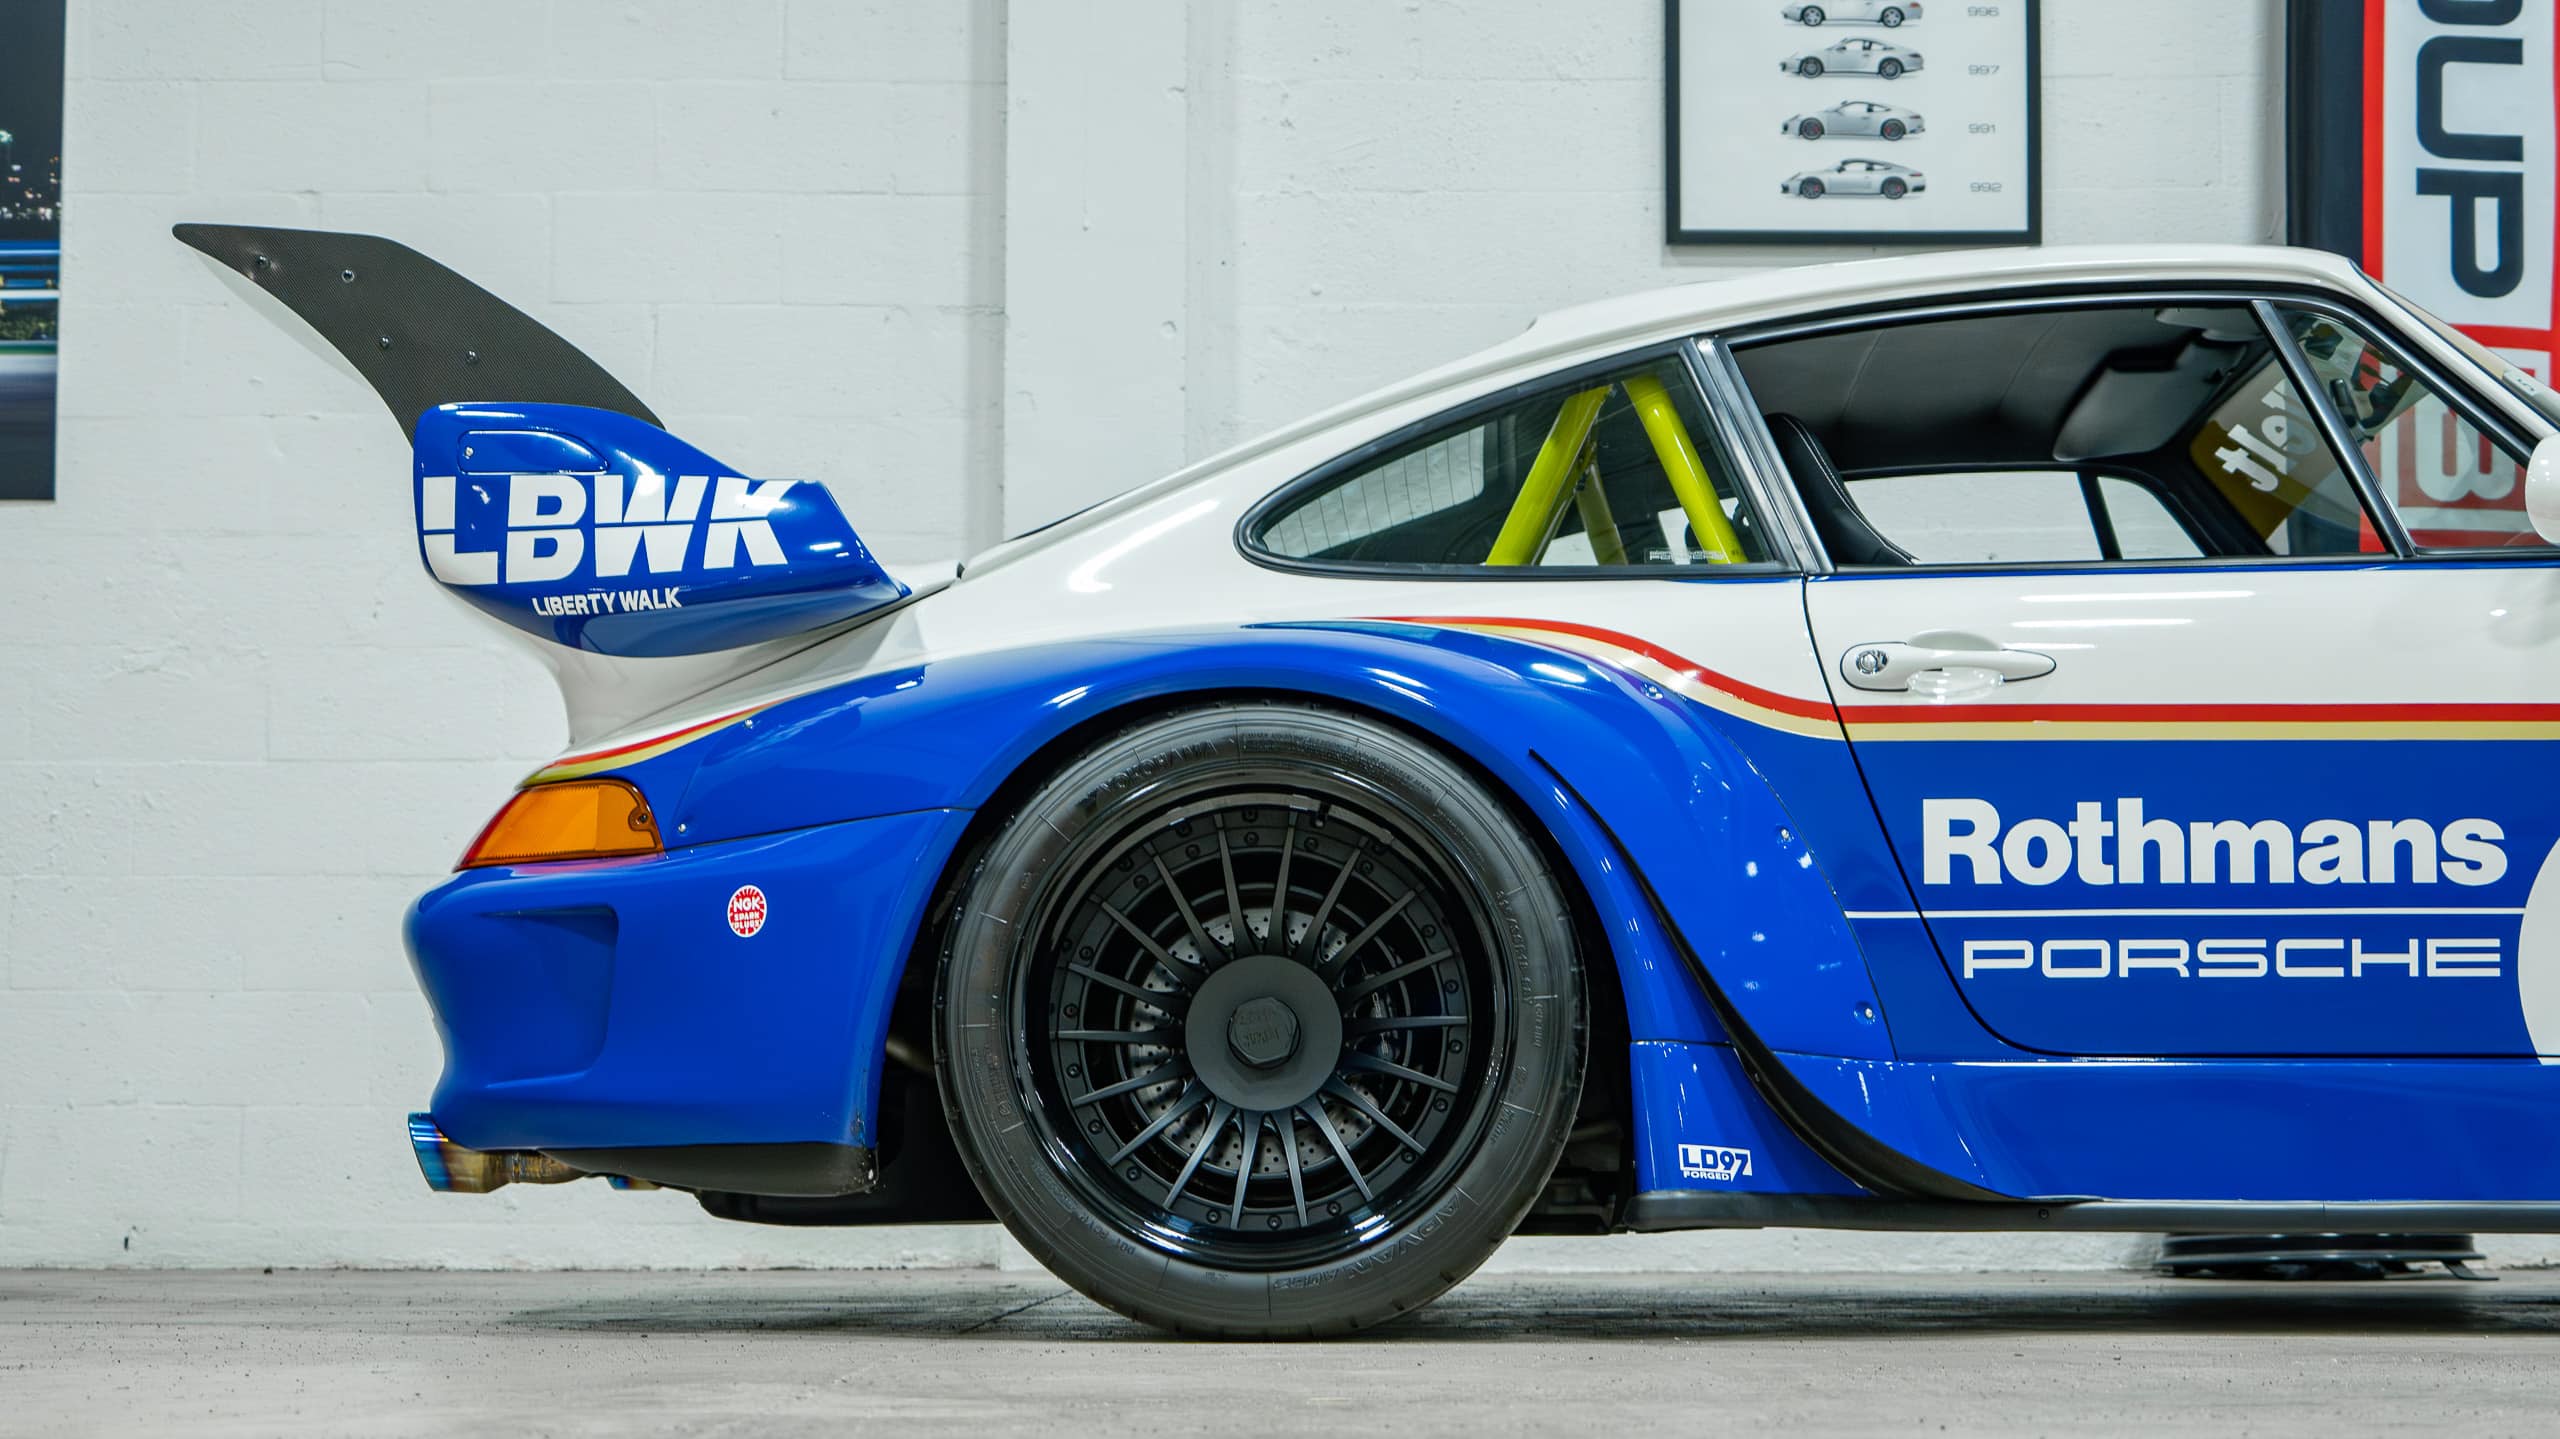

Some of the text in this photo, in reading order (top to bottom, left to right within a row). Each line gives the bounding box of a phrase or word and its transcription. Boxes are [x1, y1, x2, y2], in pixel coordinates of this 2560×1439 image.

[1967, 6, 2000, 17] 996
[1968, 64, 2000, 76] 997
[1968, 123, 1997, 134] 991
[2416, 0, 2524, 298] UP
[1969, 181, 2003, 193] 992
[423, 475, 798, 585] LBWK
[532, 587, 682, 617] LIBERTY WALK
[1922, 797, 2508, 887] Rothmans
[1963, 938, 2501, 979] PORSCHE
[1681, 1146, 1750, 1178] LD97
[1683, 1170, 1730, 1181] FORGED
[1345, 1191, 1466, 1277] ADVAN
